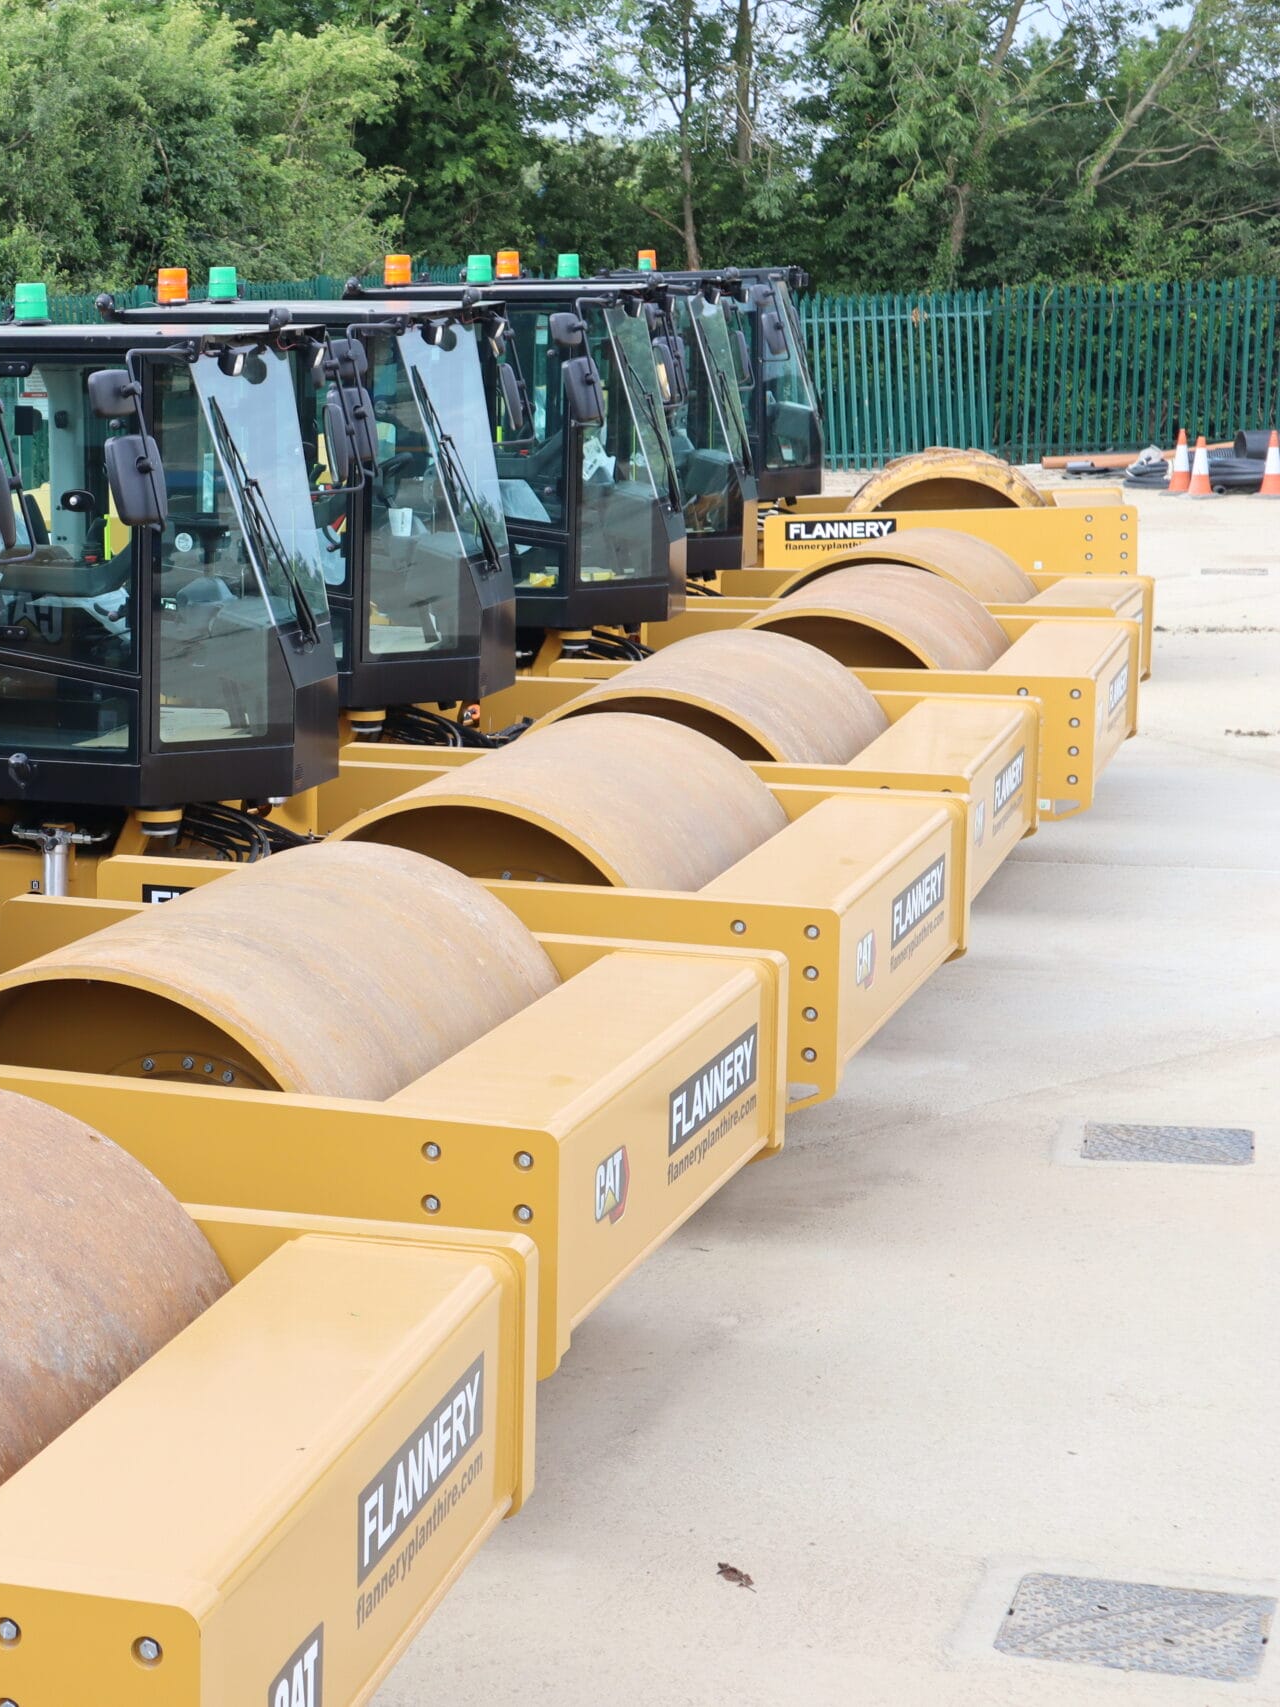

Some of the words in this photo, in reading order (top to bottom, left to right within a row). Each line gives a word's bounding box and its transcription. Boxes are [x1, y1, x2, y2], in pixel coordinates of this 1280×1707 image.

[789, 521, 893, 540] FLANNERY
[893, 861, 944, 942] FLANNERY
[856, 931, 874, 985] CAT
[672, 1034, 755, 1145] FLANNERY
[667, 1094, 758, 1186] flanneryplanthire.com
[596, 1148, 624, 1220] CAT
[363, 1370, 481, 1568] FLANNERY
[356, 1451, 483, 1631] flanneryplanthire.com
